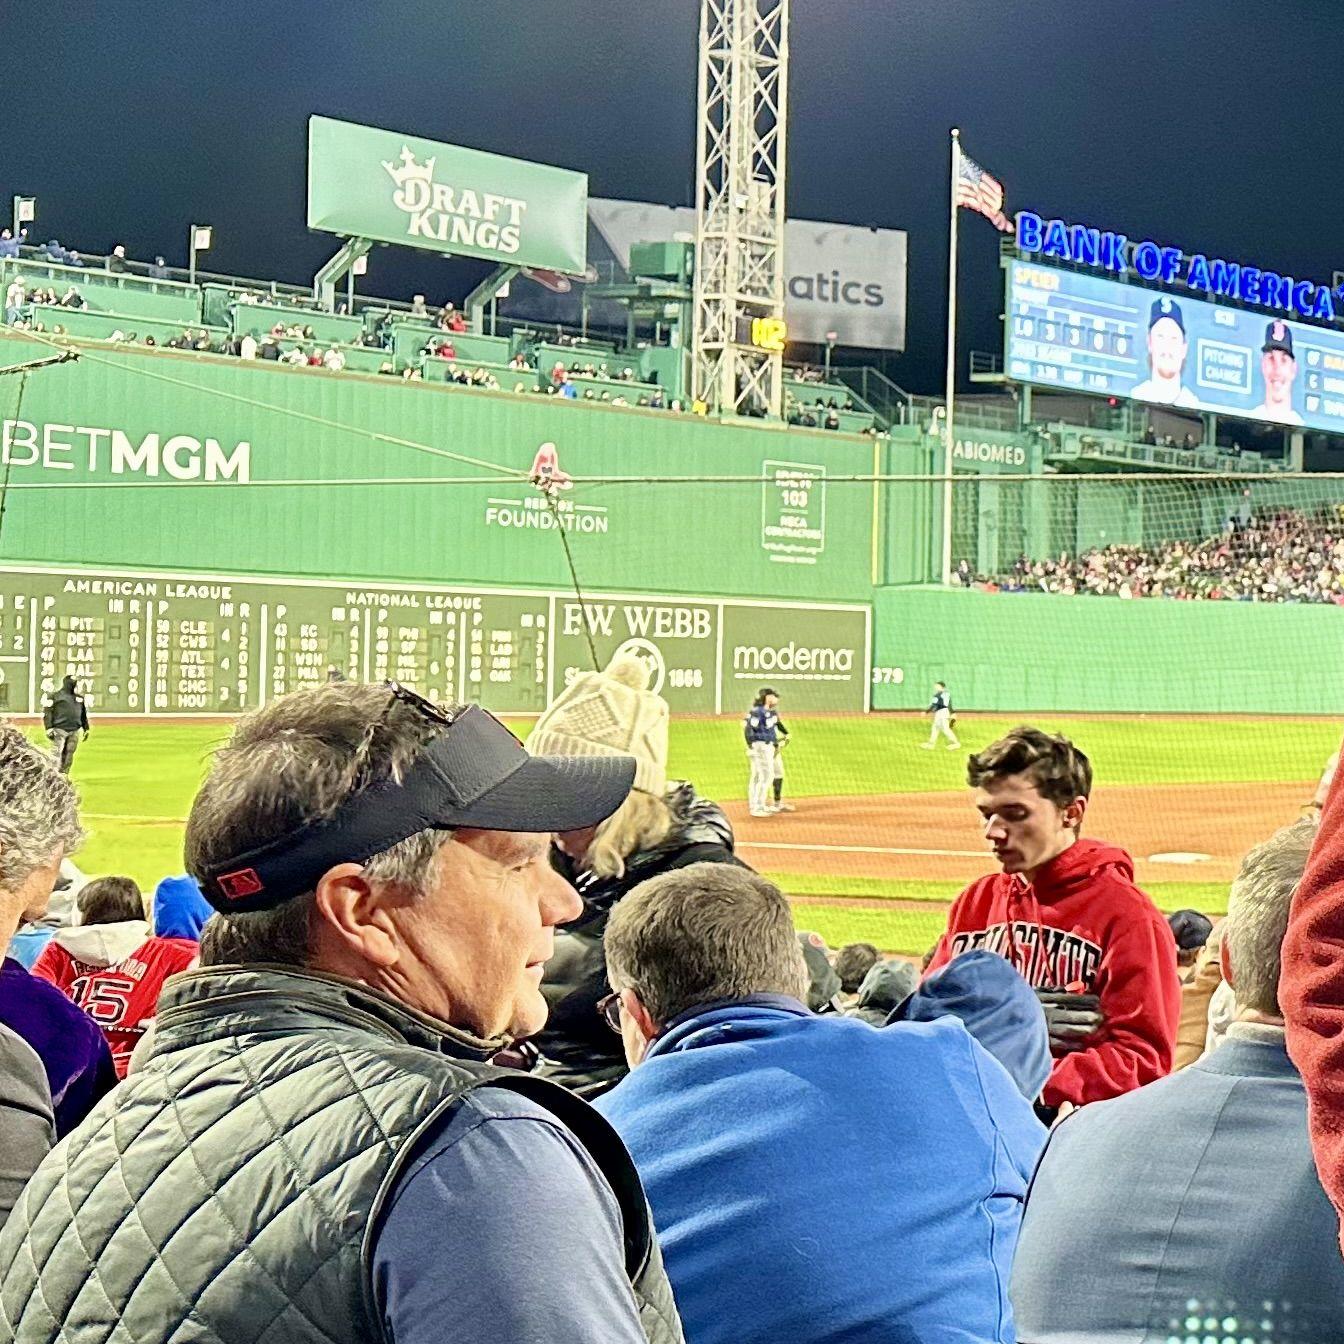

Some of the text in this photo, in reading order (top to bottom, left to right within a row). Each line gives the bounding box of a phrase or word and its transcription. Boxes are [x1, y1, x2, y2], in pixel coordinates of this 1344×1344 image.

[393, 178, 527, 225] DRAFT
[407, 208, 520, 254] KINGS
[1014, 210, 1338, 323] BANK OF AMERICA
[788, 270, 884, 307] atics
[2, 419, 250, 485] BETMGM
[952, 440, 1026, 467] ABIOMED
[486, 508, 608, 533] FOUNDATION
[63, 579, 232, 599] AMERICAN LEAGUE
[14, 595, 24, 610] E
[44, 596, 140, 613] P IN R
[158, 600, 250, 618] P IN R
[346, 592, 482, 610] NATIONAL LEAGUE
[276, 604, 287, 620] P
[378, 608, 388, 623] P
[473, 612, 483, 626] P
[70, 616, 94, 632] PIT
[180, 620, 207, 635] CLE
[563, 603, 712, 640] F.W. WEBB
[221, 628, 231, 643] 4
[300, 623, 319, 638] KC
[14, 635, 24, 651] 2
[66, 631, 96, 647] DET
[129, 632, 140, 647] 0
[179, 634, 208, 649] CWS
[238, 635, 249, 650] 2
[67, 647, 95, 662] LAA
[180, 650, 249, 665] ATL 0
[733, 641, 855, 672] moderna
[180, 664, 206, 679] TEX
[220, 657, 230, 671] 4
[871, 667, 904, 685] 379
[128, 678, 139, 693] 0
[178, 679, 207, 694] CHC
[127, 693, 138, 708] 0
[177, 694, 207, 709] HOU
[71, 975, 135, 1026] 15
